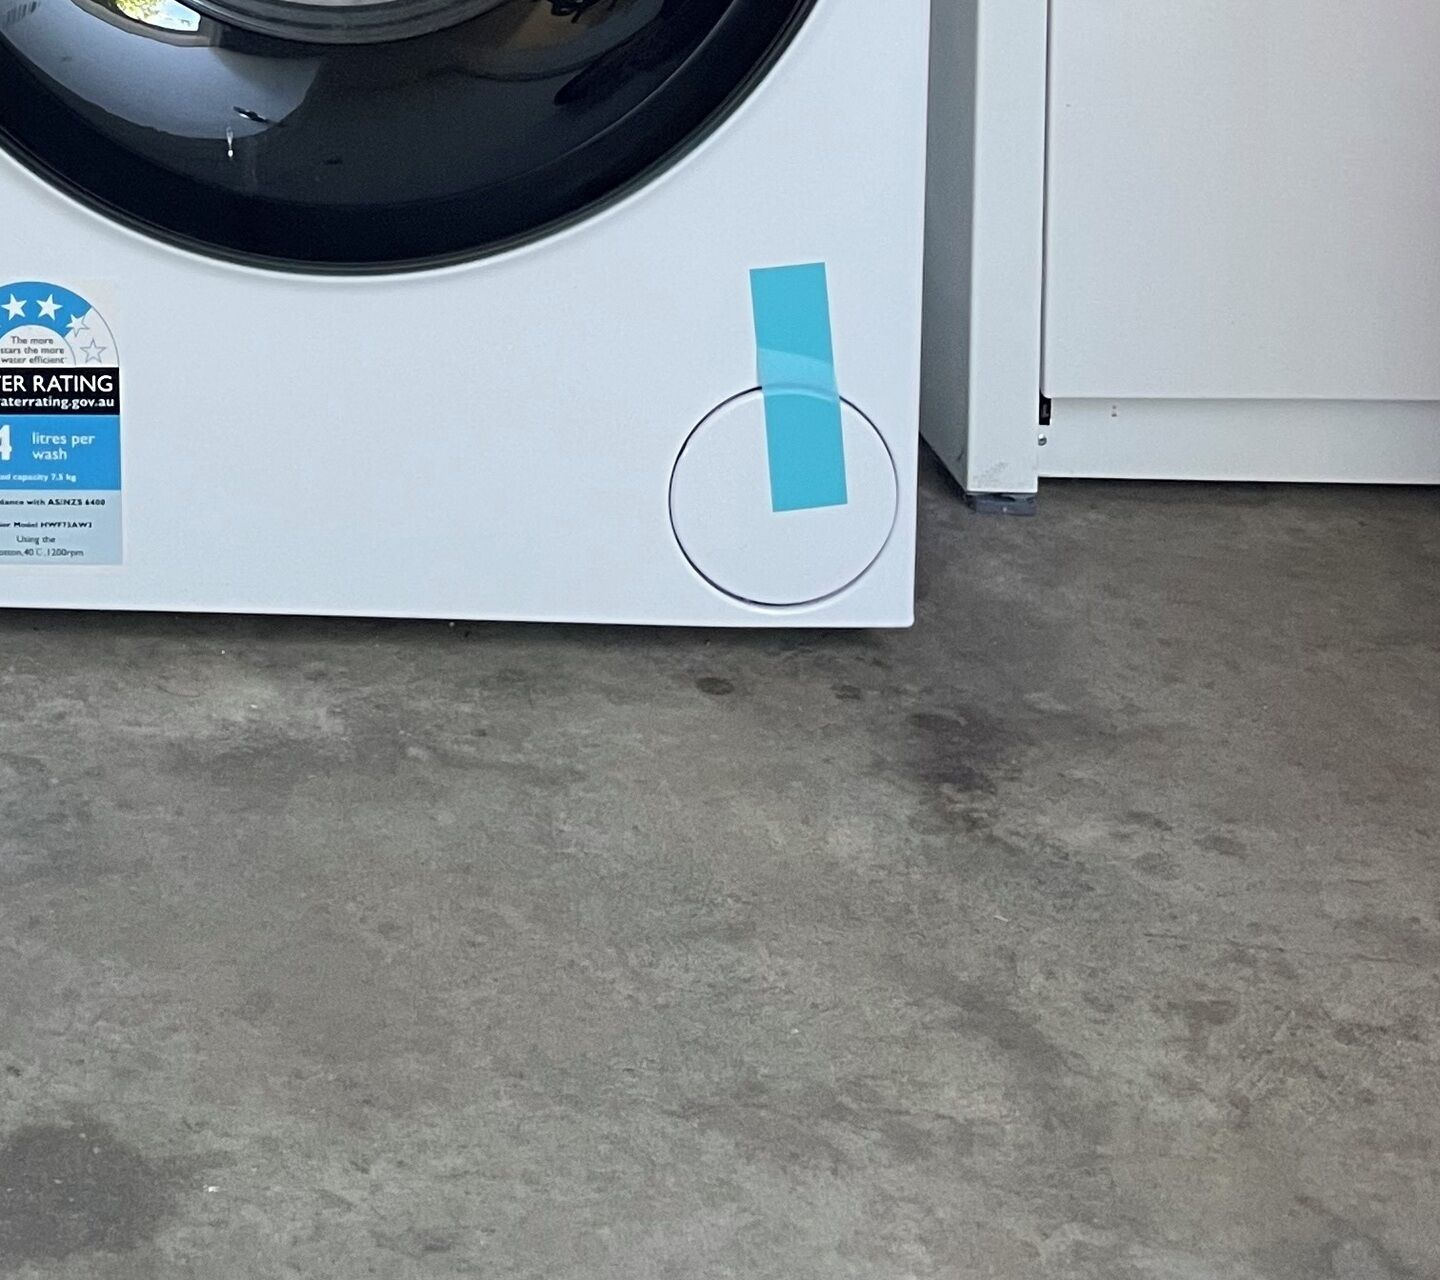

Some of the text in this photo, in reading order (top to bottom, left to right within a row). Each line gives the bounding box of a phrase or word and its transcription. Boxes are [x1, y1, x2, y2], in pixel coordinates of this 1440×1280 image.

[10, 336, 28, 344] The
[33, 375, 113, 392] RATING
[32, 432, 67, 445] litres
[71, 435, 95, 448] per
[32, 448, 68, 460] wash
[13, 474, 48, 482] capacity
[65, 473, 76, 482] kg
[16, 535, 56, 545] Using the
